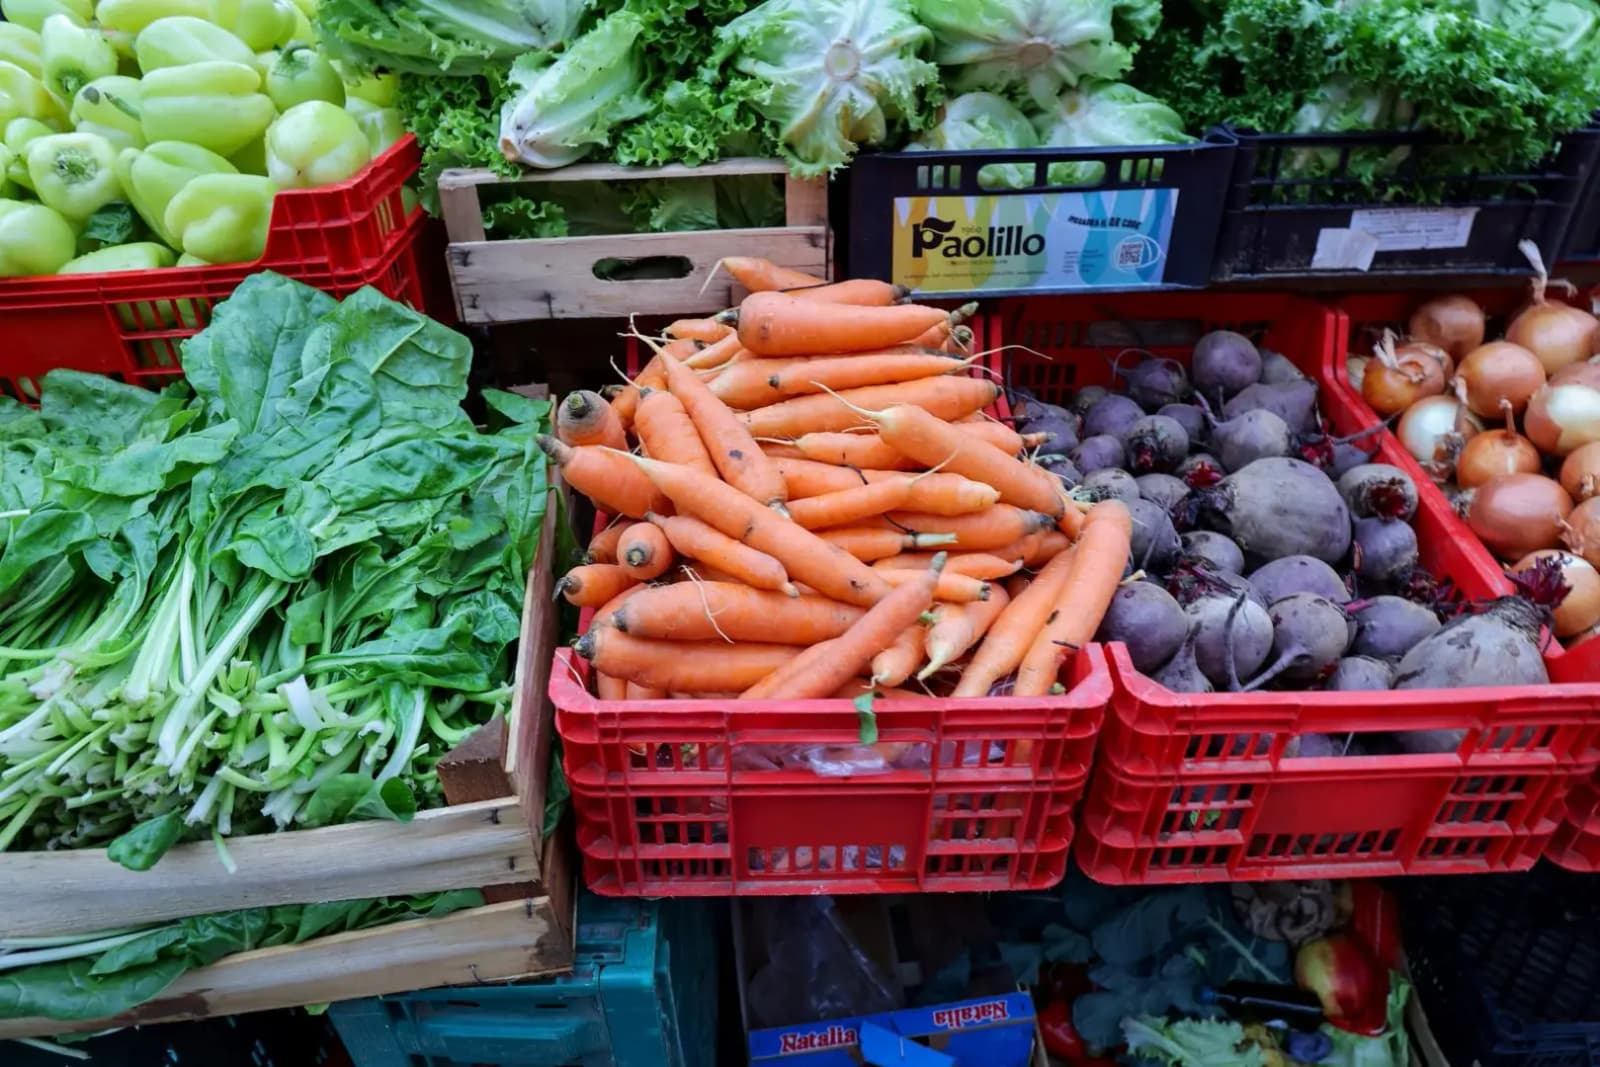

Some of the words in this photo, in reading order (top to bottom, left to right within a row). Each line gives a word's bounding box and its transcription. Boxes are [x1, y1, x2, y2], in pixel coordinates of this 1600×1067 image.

[912, 218, 1046, 258] Paolillo
[933, 1001, 1009, 1029] Natalia
[780, 1026, 857, 1054] Natalia
